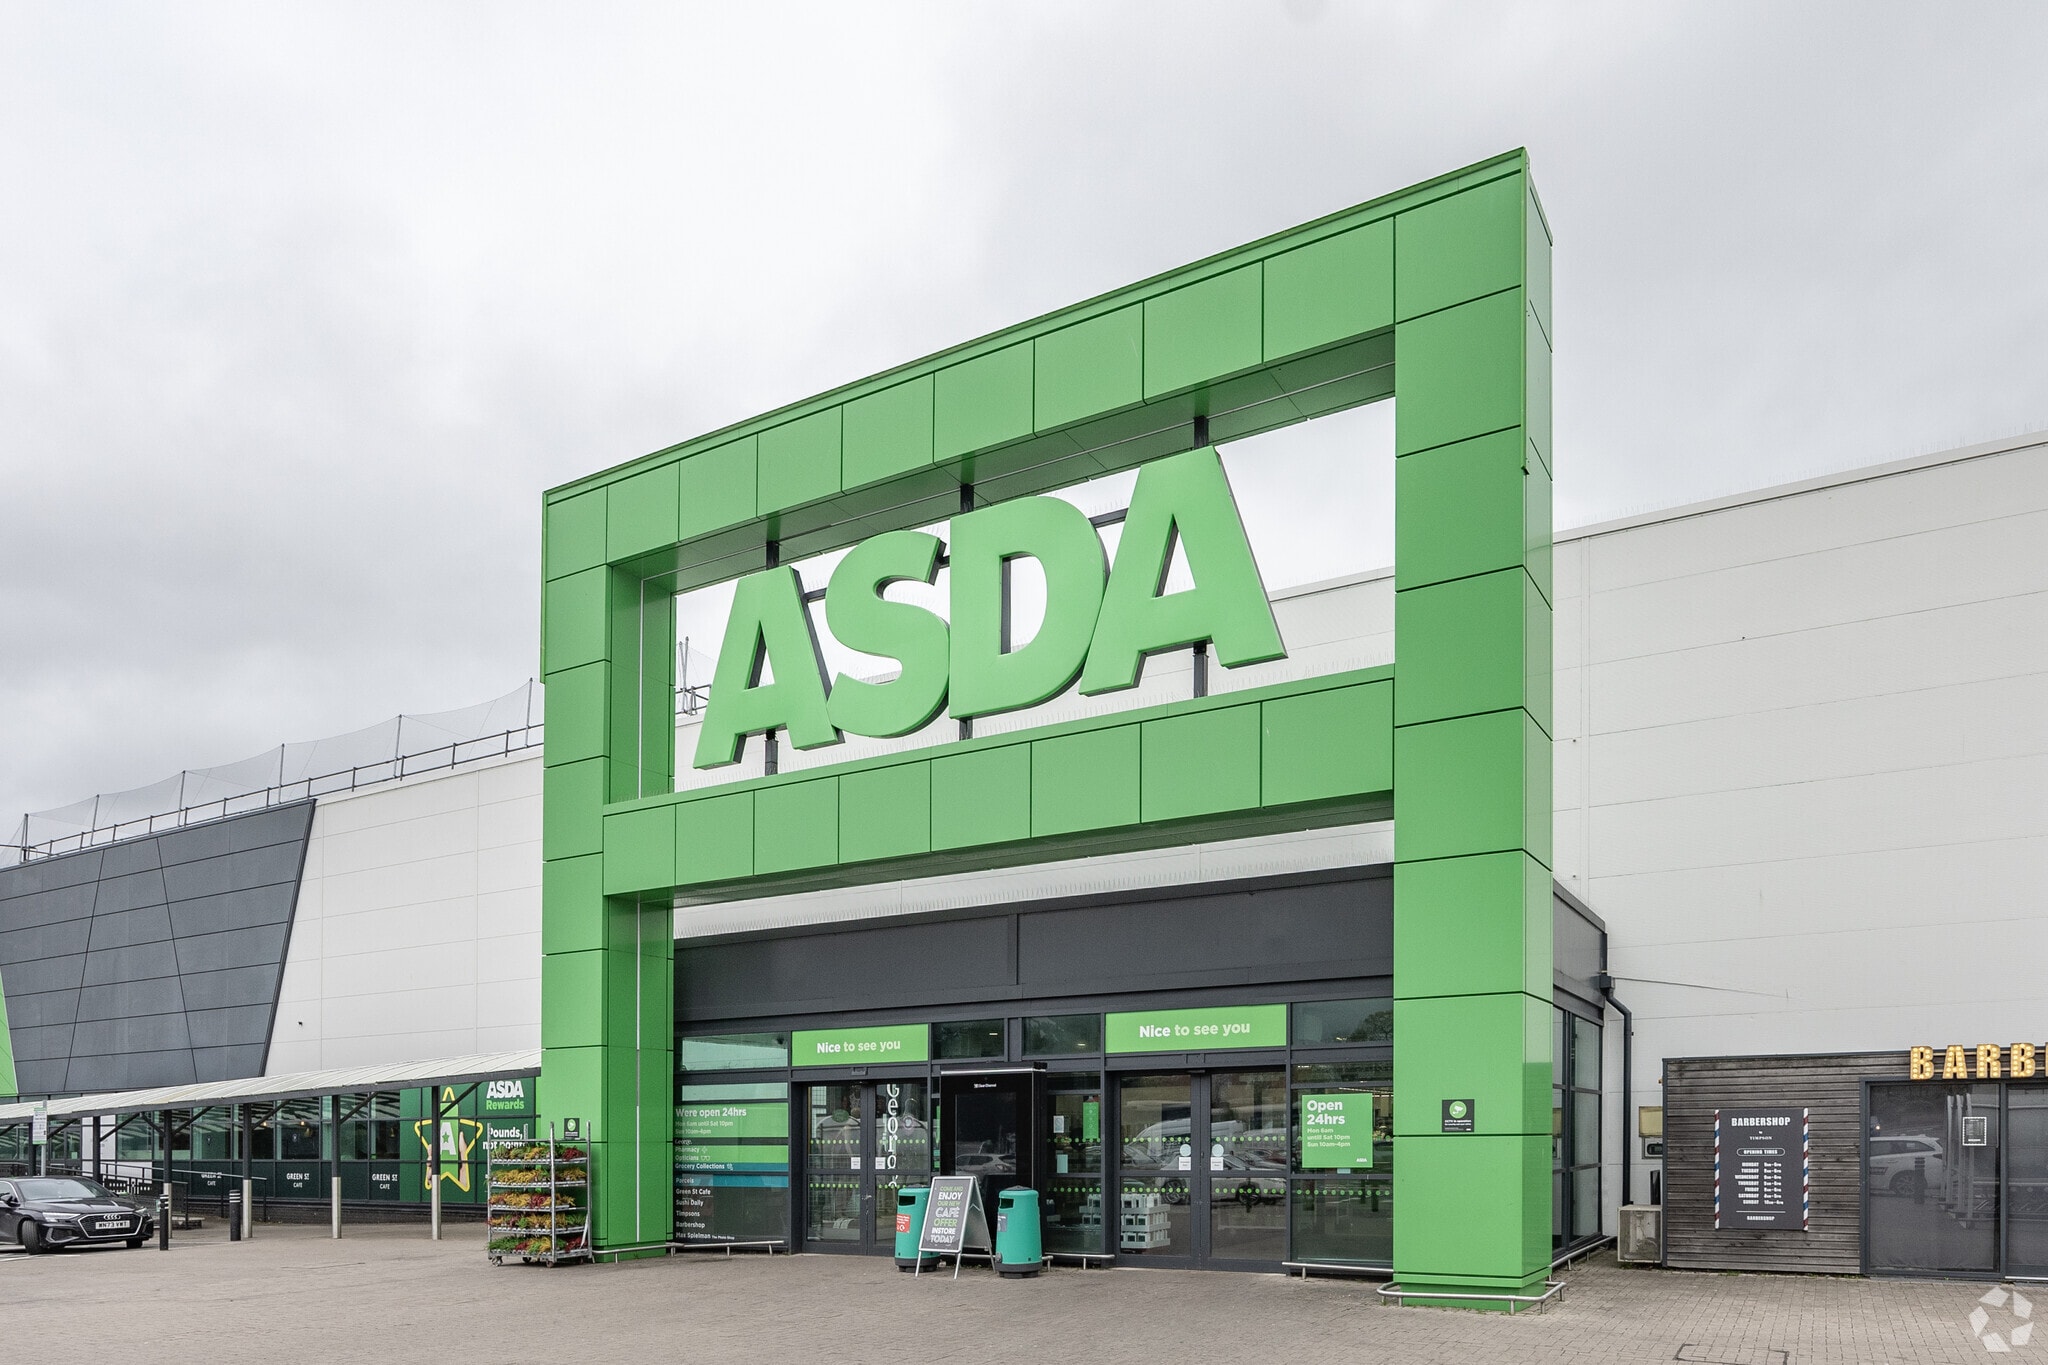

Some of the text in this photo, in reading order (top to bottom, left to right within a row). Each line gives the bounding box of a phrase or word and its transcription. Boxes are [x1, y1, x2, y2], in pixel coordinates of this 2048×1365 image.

[693, 445, 1288, 769] ASDA
[1139, 1023, 1250, 1038] Nice to see you
[816, 1040, 901, 1054] Nice to see you
[486, 1080, 524, 1099] ASDA
[486, 1099, 525, 1110] Rewards
[1307, 1100, 1343, 1113] Open
[676, 1107, 747, 1118] Were open 24hrs
[1307, 1113, 1346, 1125] 24hrs
[1731, 1117, 1791, 1127] BARBERSHOP
[372, 1173, 391, 1182] GREEN
[938, 1192, 963, 1200] ENJOY
[675, 1221, 706, 1229] Barbershop
[933, 1218, 958, 1227] OFFER
[931, 1227, 956, 1235] INSTORE
[930, 1235, 955, 1244] TODAY
